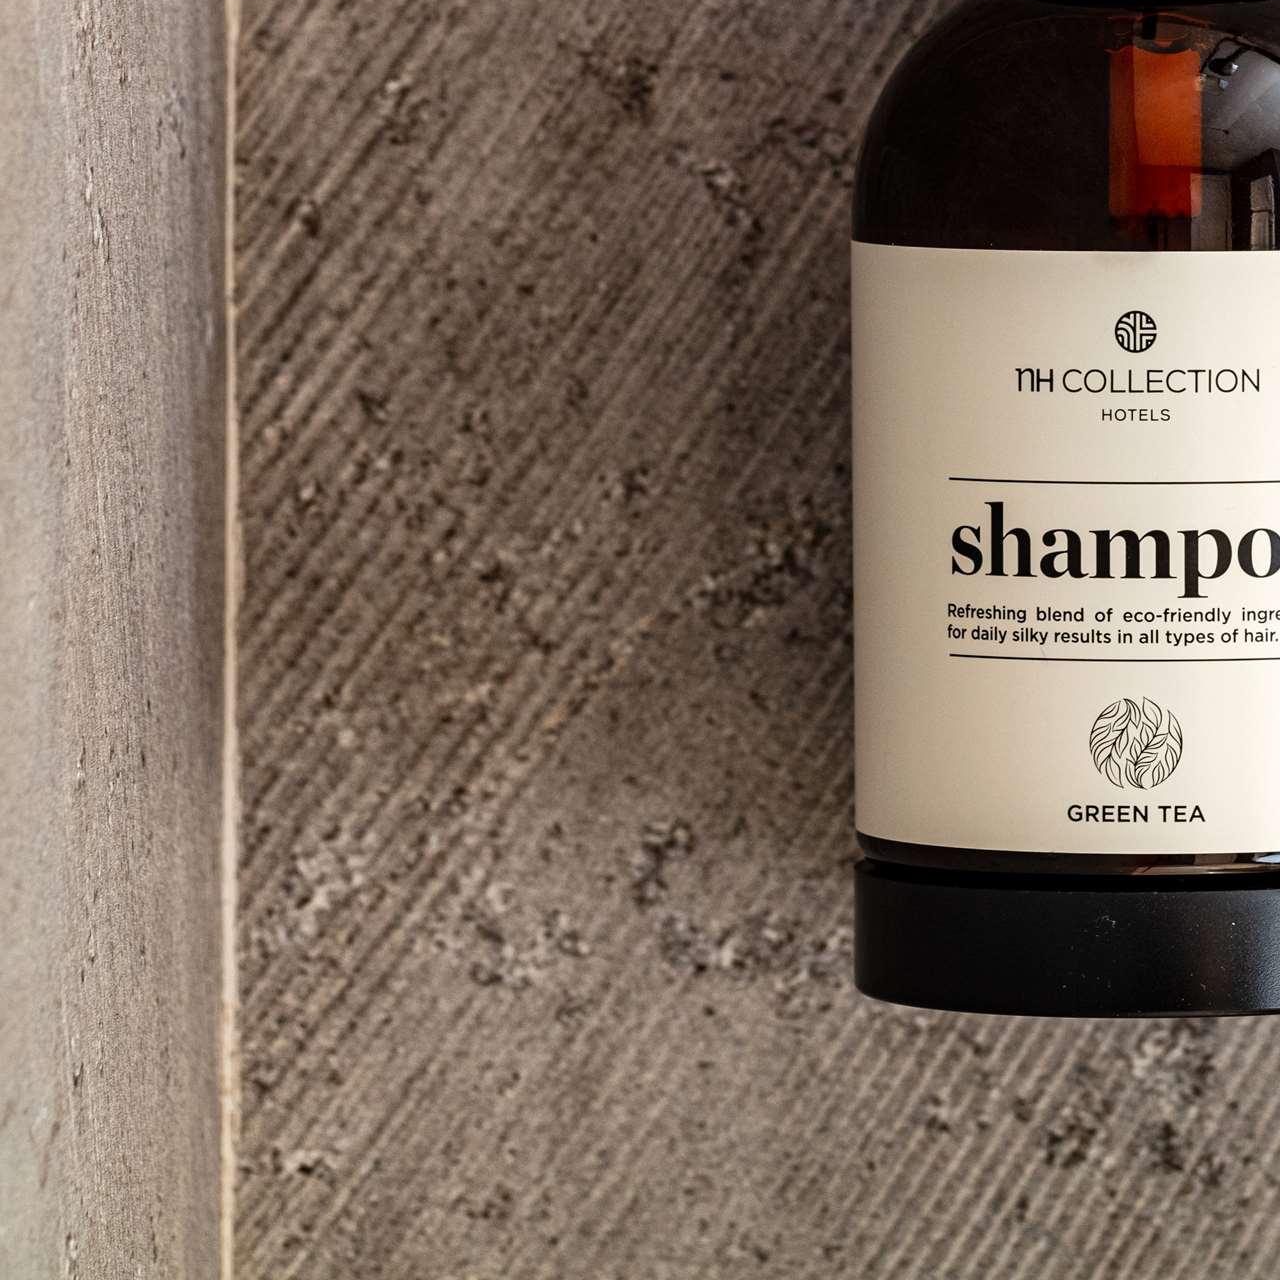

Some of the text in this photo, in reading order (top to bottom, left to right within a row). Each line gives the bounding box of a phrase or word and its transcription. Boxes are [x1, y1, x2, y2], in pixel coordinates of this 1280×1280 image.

[1062, 368, 1259, 393] COLLECTION
[1101, 408, 1170, 421] HOTELS
[947, 602, 1026, 623] Refreshing
[1035, 606, 1084, 622] blend
[1094, 607, 1113, 622] of
[1122, 607, 1231, 624] eco-friendly
[946, 623, 1278, 646] for daily silky results in all types of hair.
[1066, 804, 1205, 823] GREEN TEA
